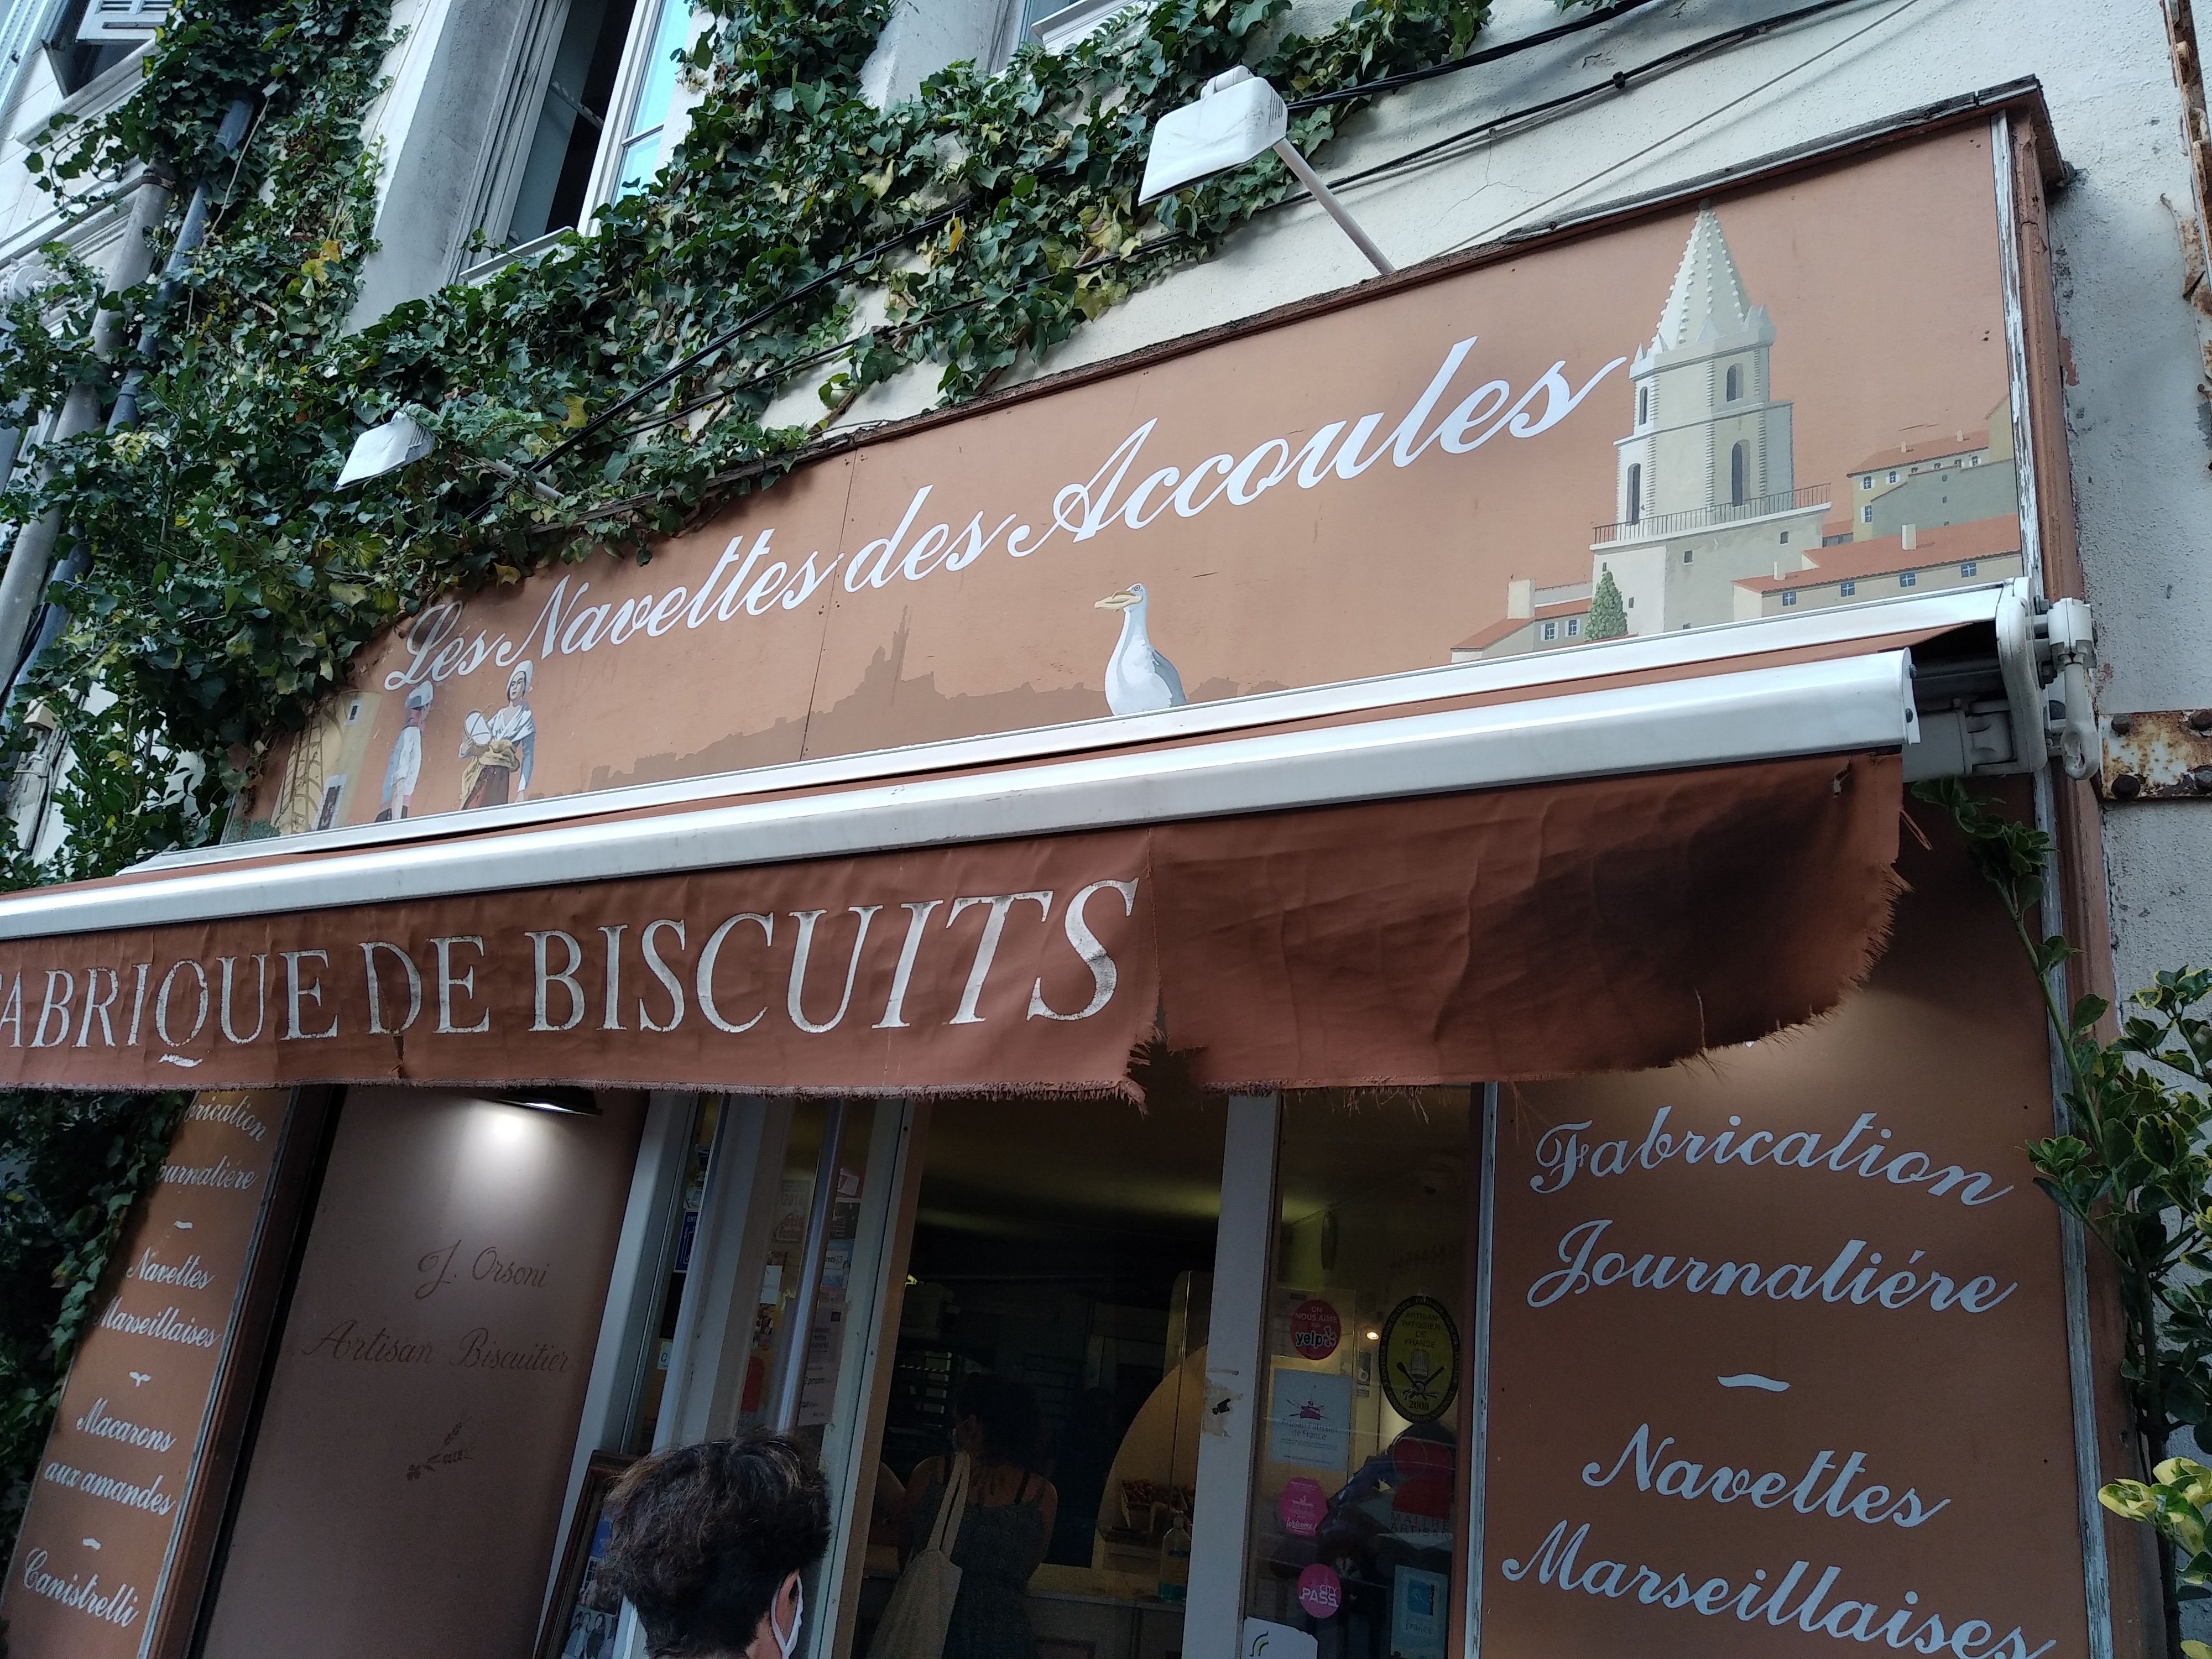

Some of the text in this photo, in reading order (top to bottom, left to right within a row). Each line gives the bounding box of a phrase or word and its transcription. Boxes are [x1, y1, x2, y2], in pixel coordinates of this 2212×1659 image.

[384, 335, 1627, 691] Les Navettes des Accoules
[0, 877, 1139, 1068] ABRIQUE DE BISCUITS
[182, 1093, 269, 1142] brication
[1529, 1105, 2014, 1206] Fabrication
[127, 1244, 216, 1290] Navettes
[471, 1245, 550, 1288] Orsoni
[1527, 1219, 2018, 1313] Journaliére
[92, 1294, 222, 1349] Marseillaises
[1295, 1313, 1338, 1323] NOUS AIME
[1296, 1331, 1323, 1348] yelp
[1402, 1321, 1440, 1331] PATISSIER
[1405, 1312, 1438, 1321] ARTISAN
[301, 1319, 573, 1373] Artisan Biscuitier
[1404, 1339, 1436, 1348] FRANCE
[76, 1397, 177, 1454] Macarons
[1302, 1430, 1327, 1441] France
[44, 1460, 177, 1517] aux amandes
[1580, 1422, 1951, 1528] Navettes
[1390, 1522, 1450, 1540] ARTISAN
[23, 1546, 140, 1629] Canistrelli
[1298, 1587, 1339, 1608] PASS
[1319, 1584, 1338, 1595] CITY
[1500, 1519, 2057, 1659] Marseillaises
